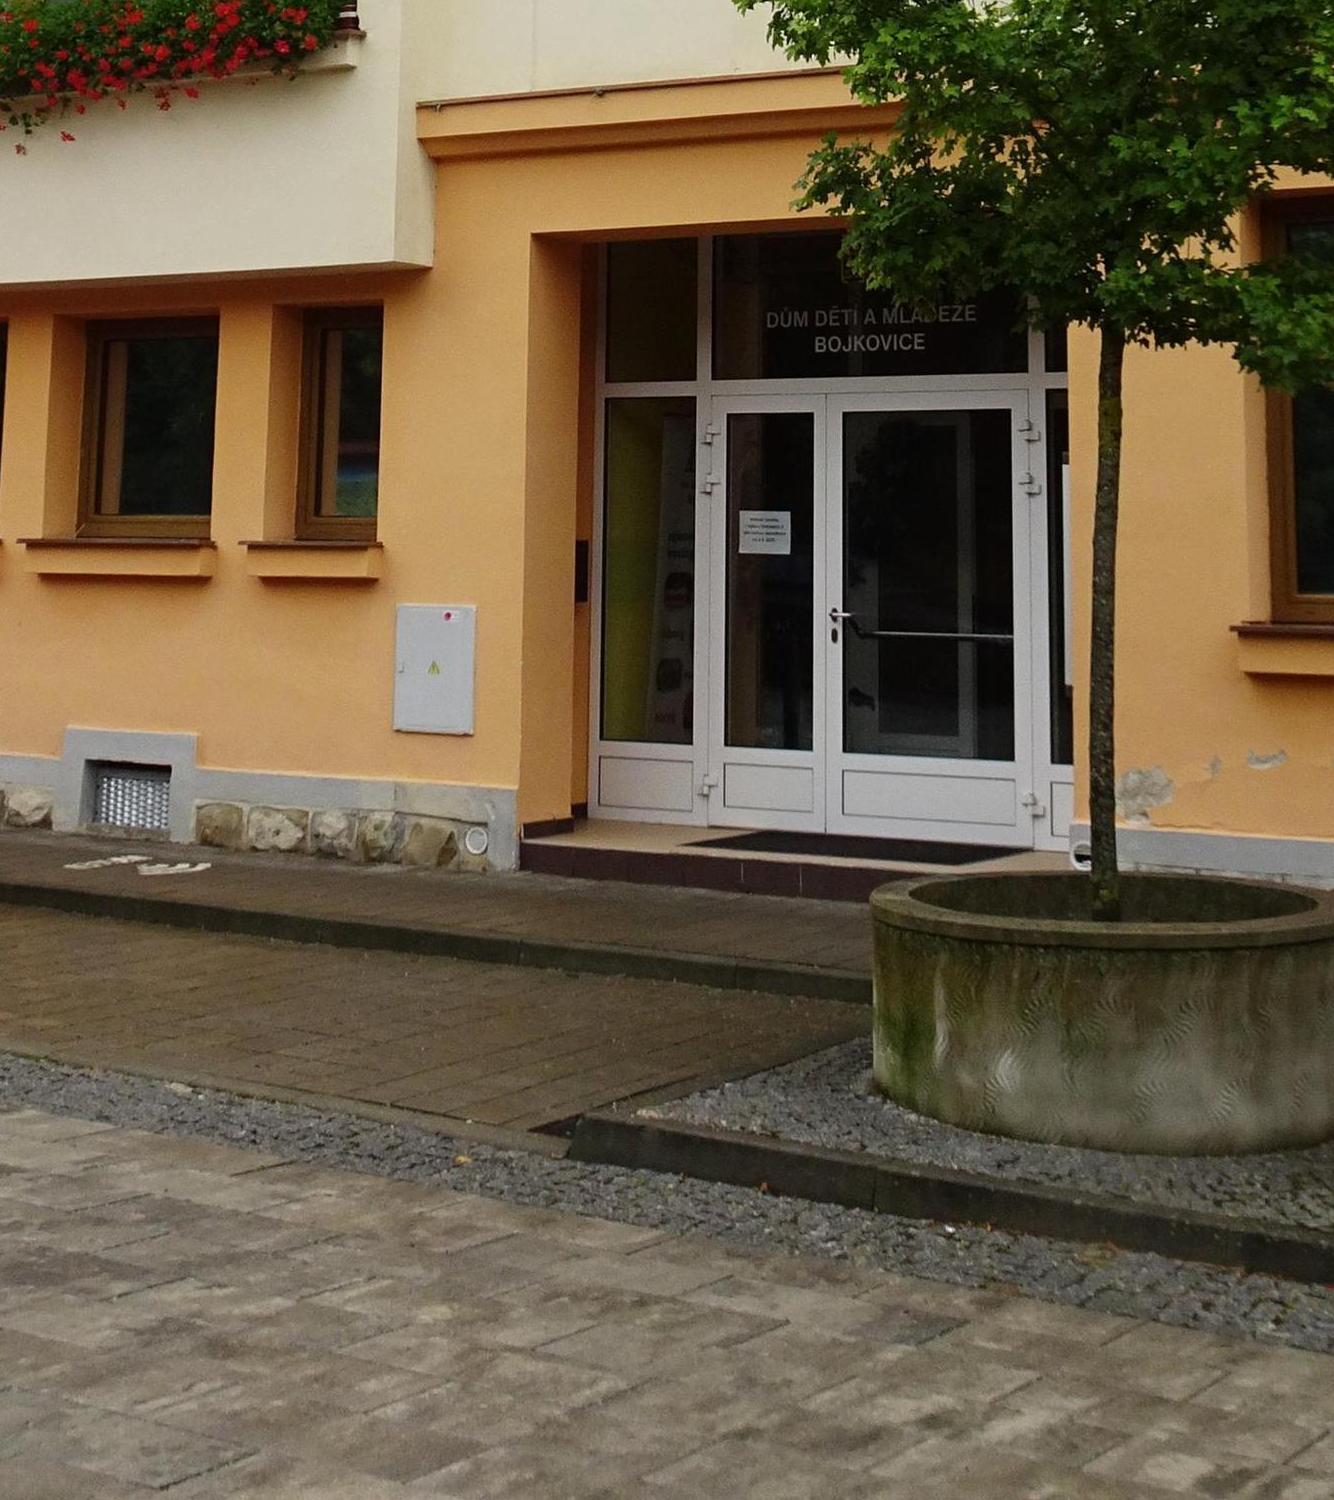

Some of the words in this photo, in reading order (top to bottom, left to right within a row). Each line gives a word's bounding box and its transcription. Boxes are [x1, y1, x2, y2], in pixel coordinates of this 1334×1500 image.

[765, 306, 809, 329] DŮM
[814, 303, 859, 327] DĚTÍ
[863, 307, 877, 325] A
[814, 332, 926, 353] BOJKOVICE
